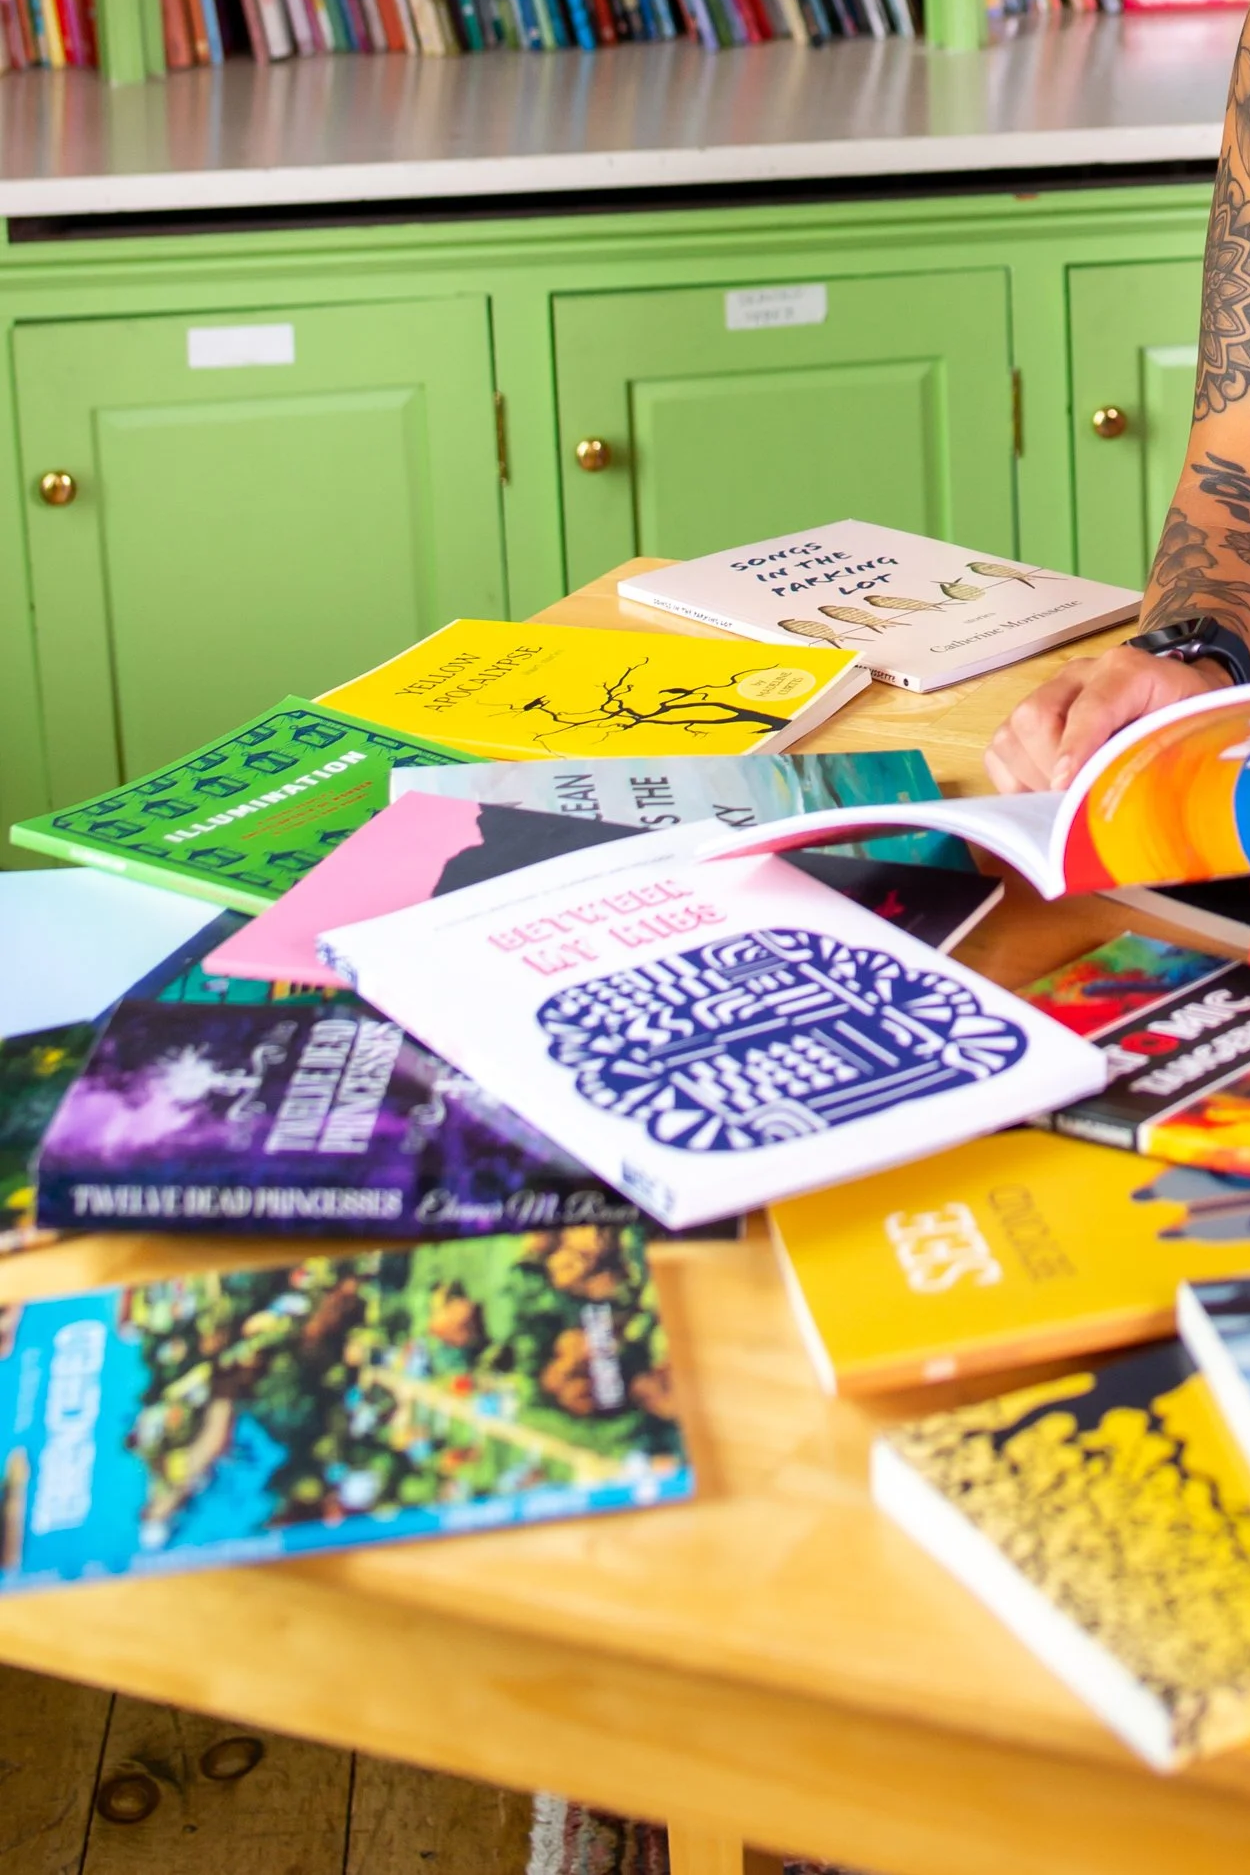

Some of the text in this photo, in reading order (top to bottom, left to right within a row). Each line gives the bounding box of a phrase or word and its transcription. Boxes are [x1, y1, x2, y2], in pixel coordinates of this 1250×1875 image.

[730, 542, 822, 571] SONGS
[757, 551, 852, 582] IN THE
[771, 557, 899, 596] PARKING
[839, 573, 892, 595] LOT
[930, 599, 1083, 653] Catherine Morrissette
[963, 612, 997, 624] stories
[395, 653, 480, 695] YELLOW
[424, 646, 543, 712] APOCALYPSE
[756, 671, 792, 697] MADELINE
[777, 677, 803, 696] CURTIS
[162, 750, 368, 844] ILLUMINATION
[630, 776, 675, 809] THE
[713, 804, 758, 827] KY
[488, 879, 694, 952] BETWEEN
[609, 904, 727, 948] RIBS
[522, 939, 600, 976] MY
[70, 1184, 183, 1219] TWELVE
[184, 1185, 252, 1219] DEAD
[253, 1187, 402, 1221] PRINCESSES
